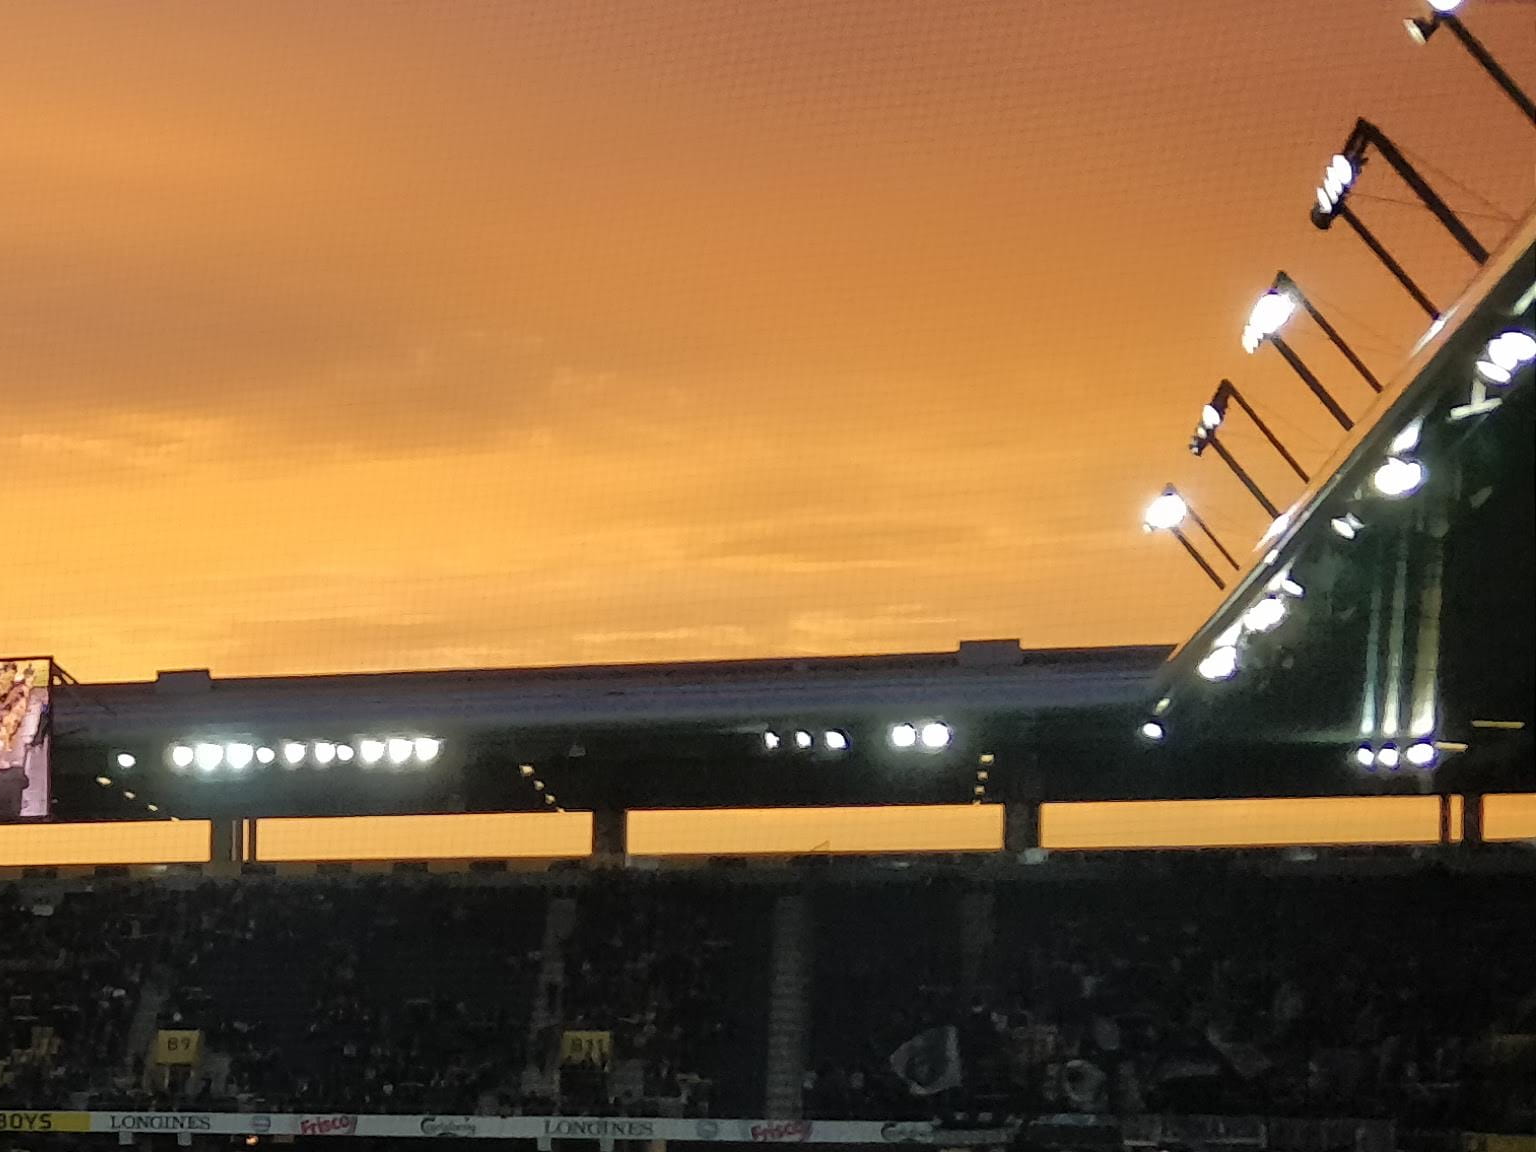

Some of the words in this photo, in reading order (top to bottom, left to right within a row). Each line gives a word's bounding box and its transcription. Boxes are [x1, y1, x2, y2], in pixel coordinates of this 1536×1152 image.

[167, 1036, 190, 1051] B9
[110, 1114, 211, 1131] LONGINES
[543, 1119, 654, 1136] LONGINES
